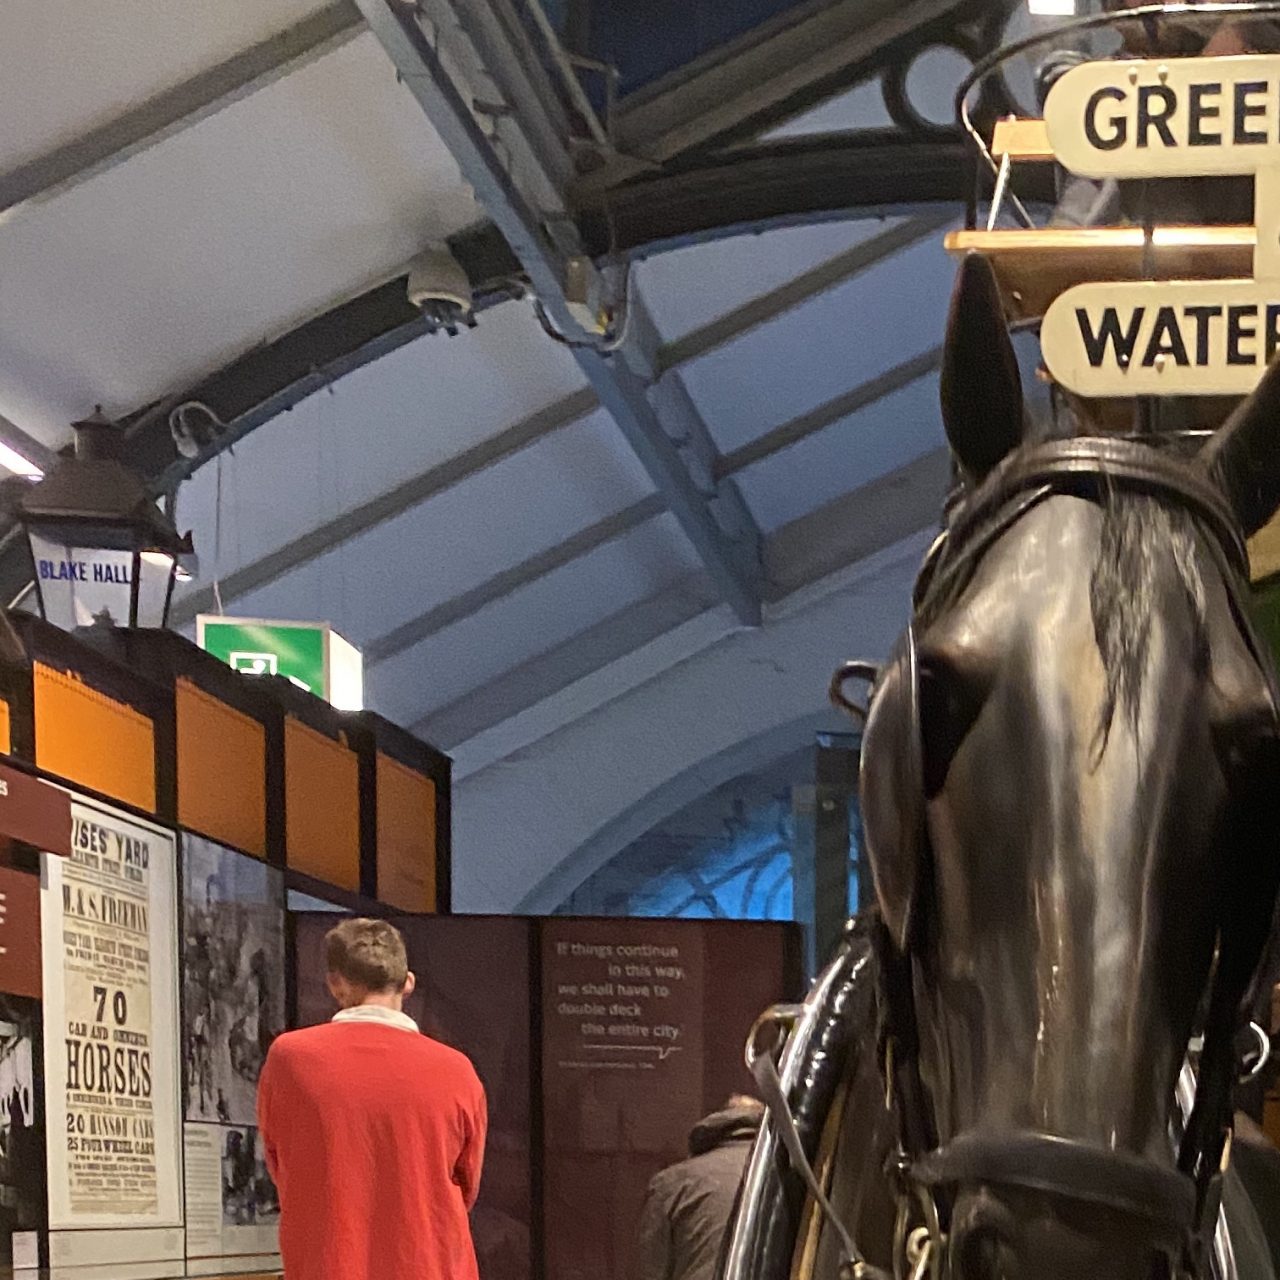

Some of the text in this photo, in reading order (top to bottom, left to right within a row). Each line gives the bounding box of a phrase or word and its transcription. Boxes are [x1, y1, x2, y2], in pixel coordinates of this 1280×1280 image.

[39, 560, 132, 584] BLAKE HALL
[115, 832, 150, 870] YARD
[571, 943, 612, 958] things
[616, 945, 679, 958] continue
[608, 963, 622, 977] in
[625, 963, 652, 977] this
[558, 983, 670, 998] we shall have to
[93, 985, 128, 1026] 70
[558, 1003, 642, 1017] double deck
[90, 1024, 109, 1041] AND
[581, 1023, 680, 1041] the entire city
[65, 1038, 152, 1098] HORSES
[66, 1112, 86, 1134] 20
[67, 1136, 79, 1151] 25
